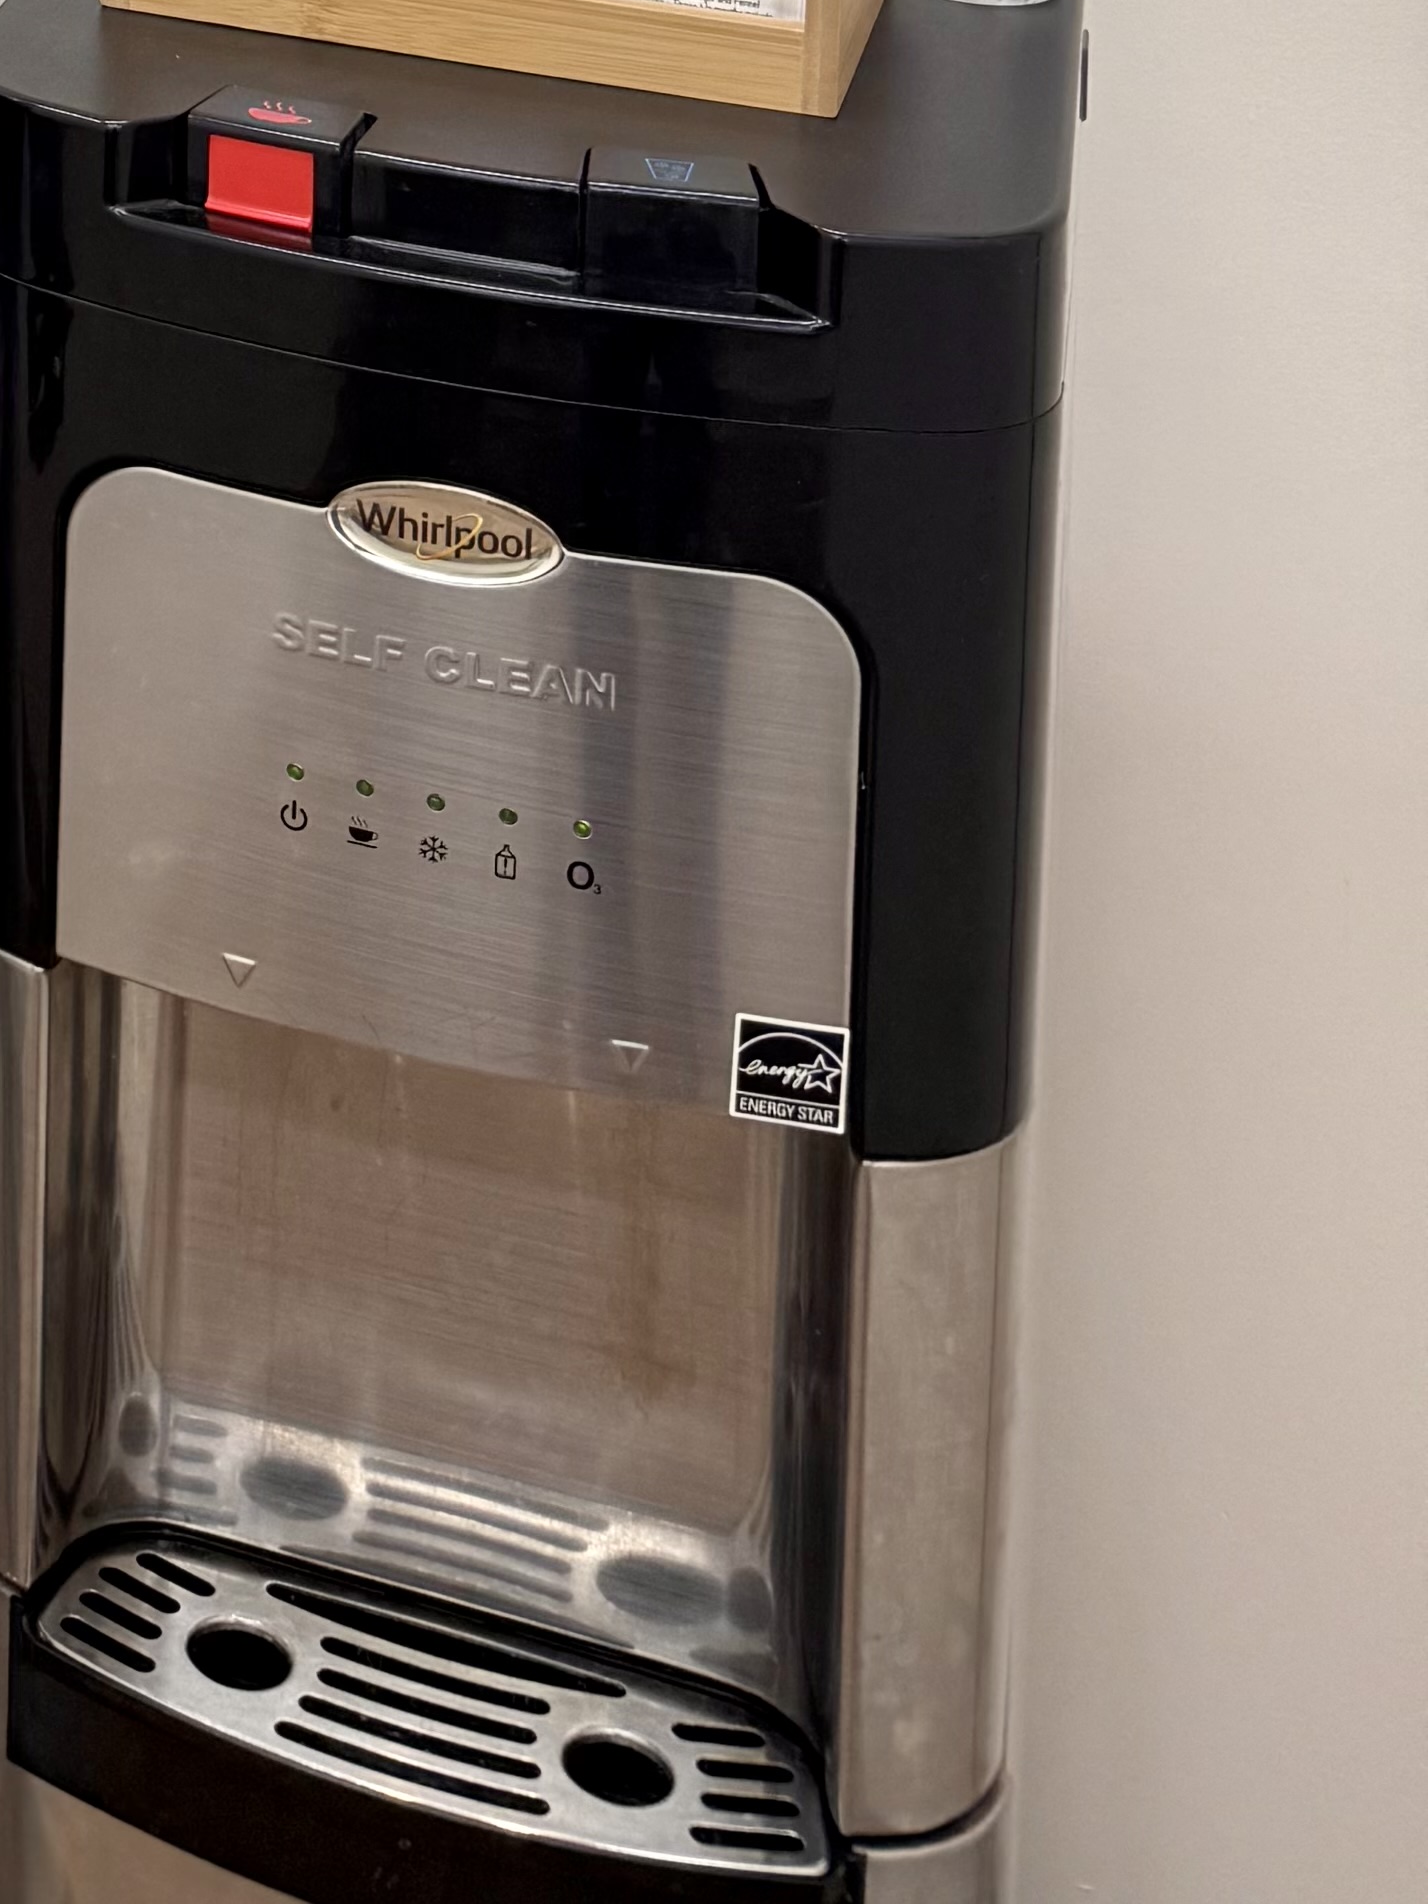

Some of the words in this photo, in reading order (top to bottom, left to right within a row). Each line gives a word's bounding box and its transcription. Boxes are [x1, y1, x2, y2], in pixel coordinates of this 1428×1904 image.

[356, 498, 533, 560] Whirlpool
[272, 611, 407, 673] SELF
[423, 645, 617, 711] CLEAN
[739, 1096, 795, 1118] ENERGY
[797, 1105, 834, 1124] STAR
